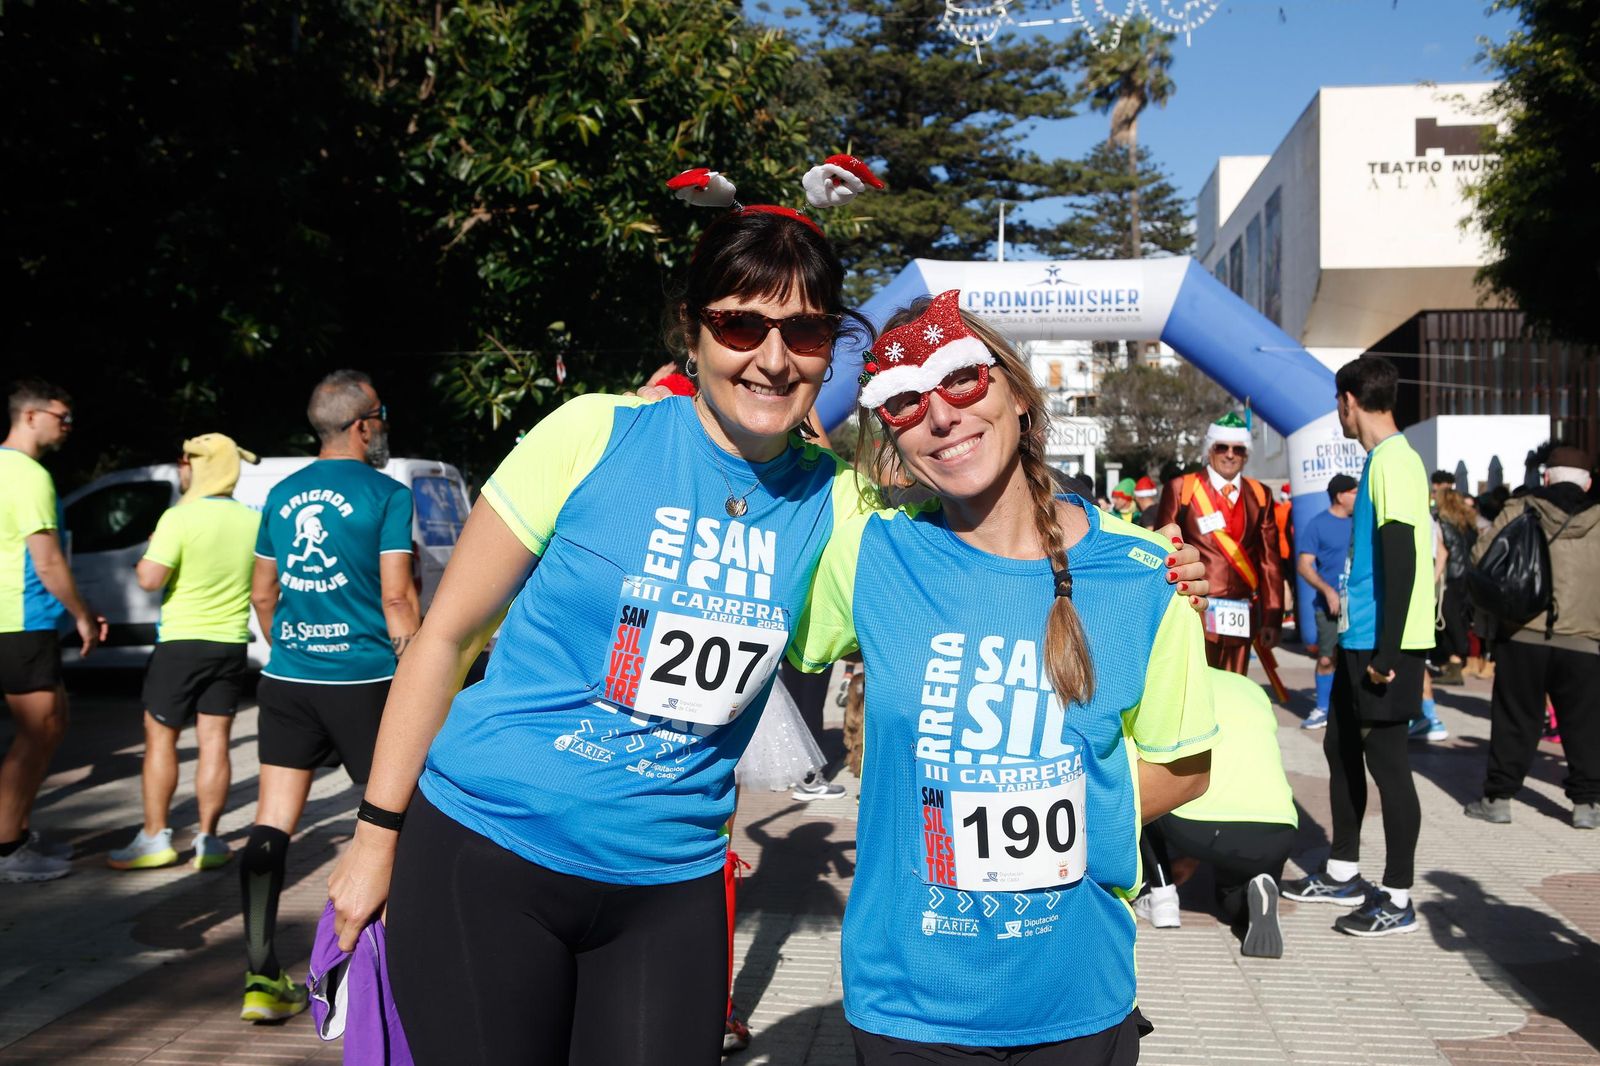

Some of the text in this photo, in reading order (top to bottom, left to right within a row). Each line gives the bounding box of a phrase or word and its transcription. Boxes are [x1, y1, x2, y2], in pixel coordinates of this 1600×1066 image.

[1368, 160, 1442, 174] TEATRO
[967, 289, 1140, 313] CRONOFINISHER
[1316, 442, 1357, 457] CRONO
[279, 488, 354, 520] BRIGADA
[693, 517, 776, 576] SAN
[280, 571, 349, 593] EMPUJE
[631, 583, 785, 623] III CARRERA
[620, 604, 649, 629] SAN
[701, 610, 785, 631] TARIFA 2024
[1218, 611, 1245, 628] 130
[613, 624, 641, 655] SIL
[609, 650, 645, 683] VES
[650, 629, 770, 695] 207
[604, 675, 639, 707] TRE
[961, 682, 1075, 759] SIL
[571, 739, 612, 760] TARIFA
[645, 770, 655, 778] de
[923, 763, 950, 783] III
[960, 753, 1082, 785] CARRERA
[922, 786, 944, 809] SAN
[995, 781, 1050, 793] TARIFA
[923, 805, 946, 834] SIL
[963, 798, 1077, 860] 190
[924, 831, 954, 862] VES
[926, 856, 957, 886] TRE
[936, 918, 980, 933] TARIFA
[1024, 914, 1059, 928] Diputación
[1024, 929, 1034, 937] de
